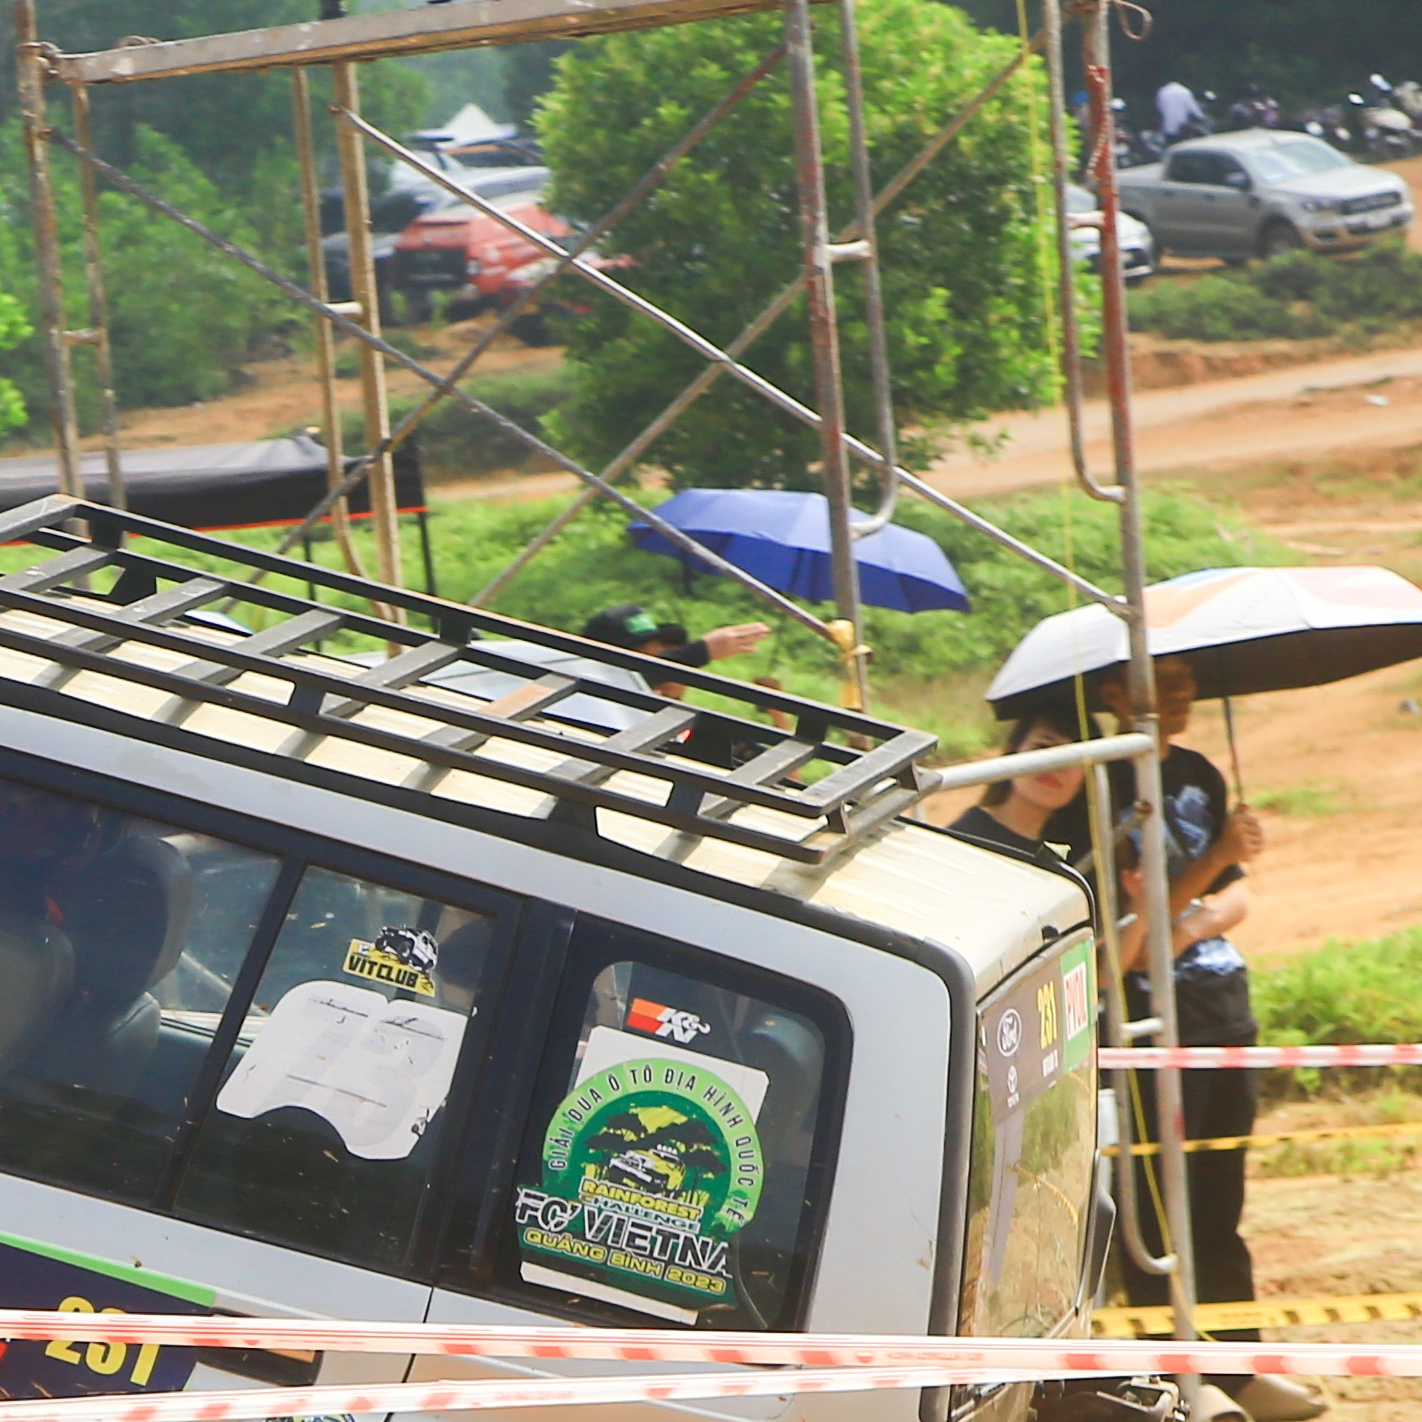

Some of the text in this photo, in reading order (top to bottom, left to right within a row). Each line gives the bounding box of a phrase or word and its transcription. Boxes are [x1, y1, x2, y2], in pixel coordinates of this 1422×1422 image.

[348, 955, 419, 989] VITCLUB
[1037, 981, 1058, 1049] 231
[607, 1072, 621, 1092] Ô
[630, 1063, 653, 1085] TÔ
[664, 1067, 697, 1091] ĐỊA
[702, 1084, 744, 1130] HÌNH
[580, 1176, 704, 1222] RAINFOREST
[607, 1248, 664, 1279] BÌNH
[664, 1266, 726, 1296] 2023
